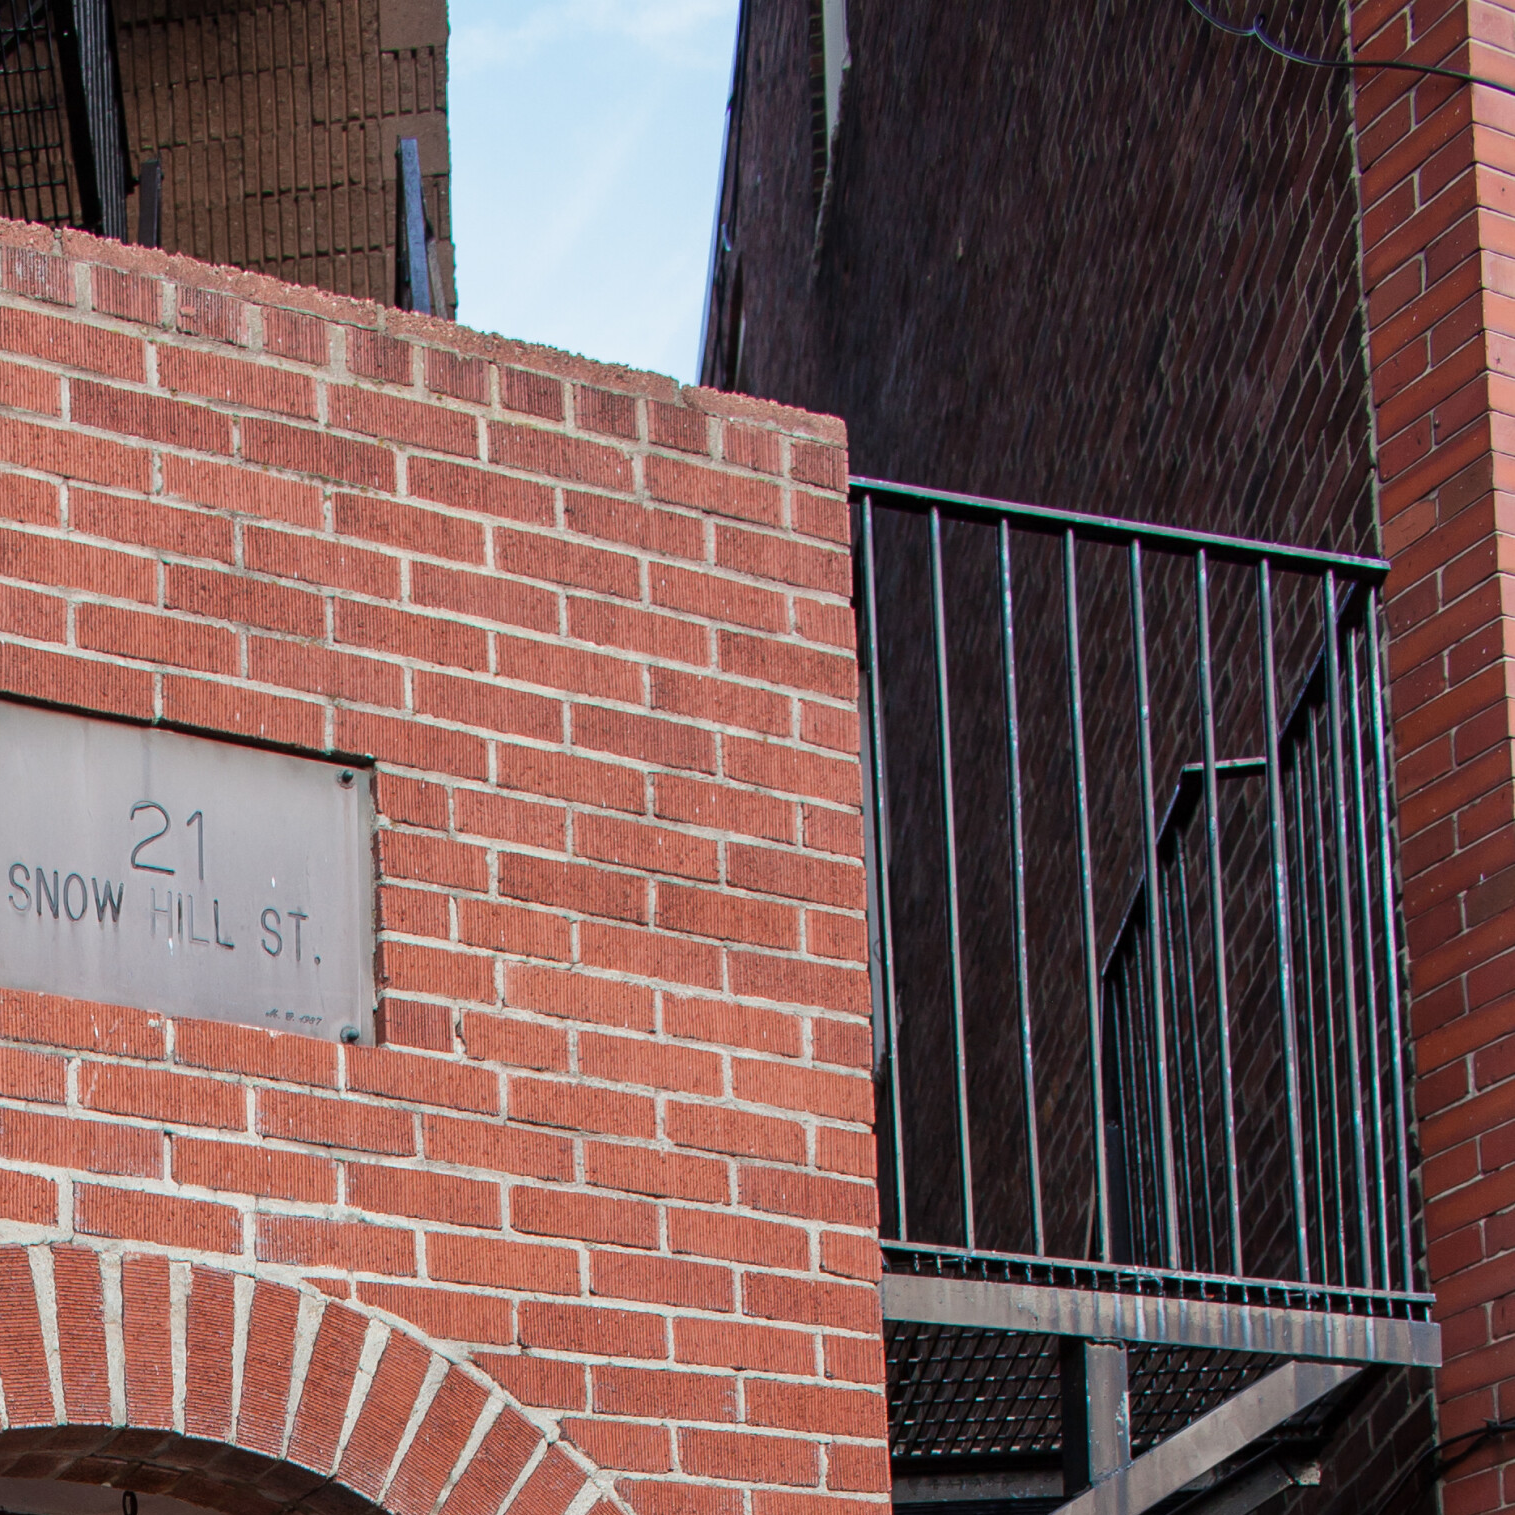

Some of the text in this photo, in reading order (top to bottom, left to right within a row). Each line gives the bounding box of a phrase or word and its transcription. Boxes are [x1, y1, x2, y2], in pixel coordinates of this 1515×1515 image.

[130, 800, 205, 881] 21
[8, 862, 322, 965] SNOW HILL ST.
